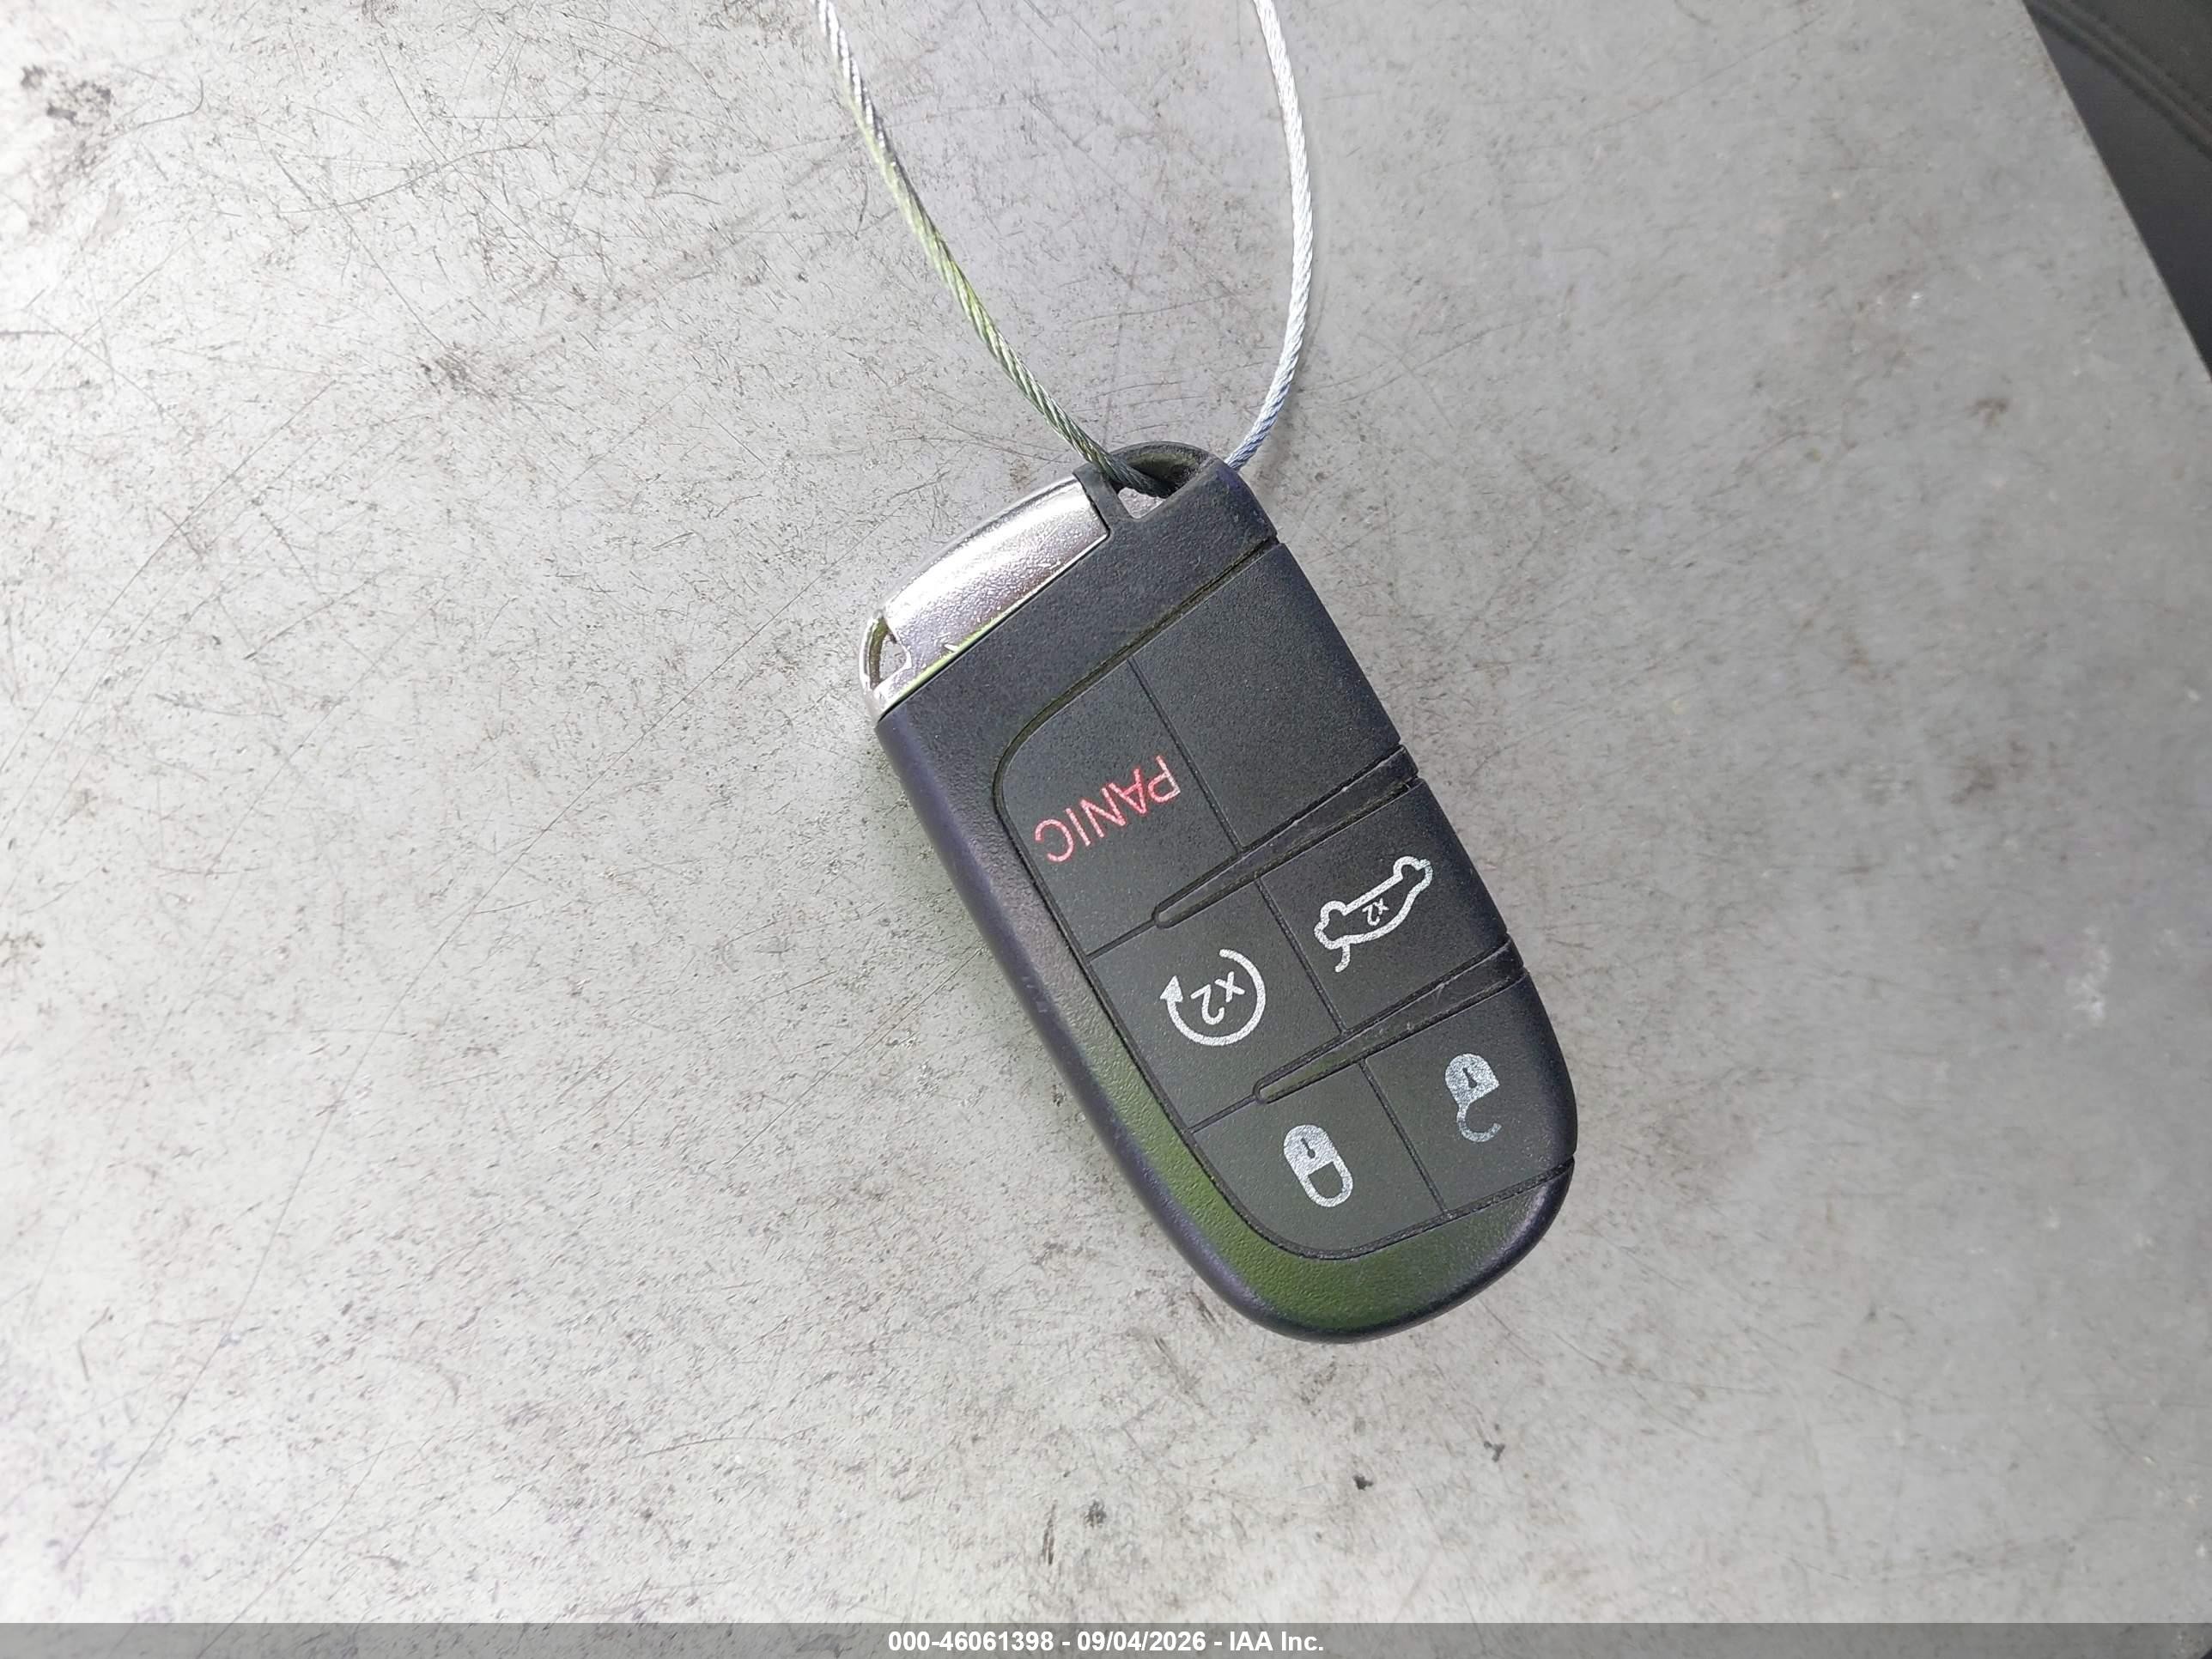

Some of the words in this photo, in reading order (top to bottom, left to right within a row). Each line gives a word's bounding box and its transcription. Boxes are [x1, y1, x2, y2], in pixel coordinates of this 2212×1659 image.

[1034, 755, 1182, 863] PANIC
[1361, 897, 1390, 927] x2
[1189, 970, 1246, 1025] x2
